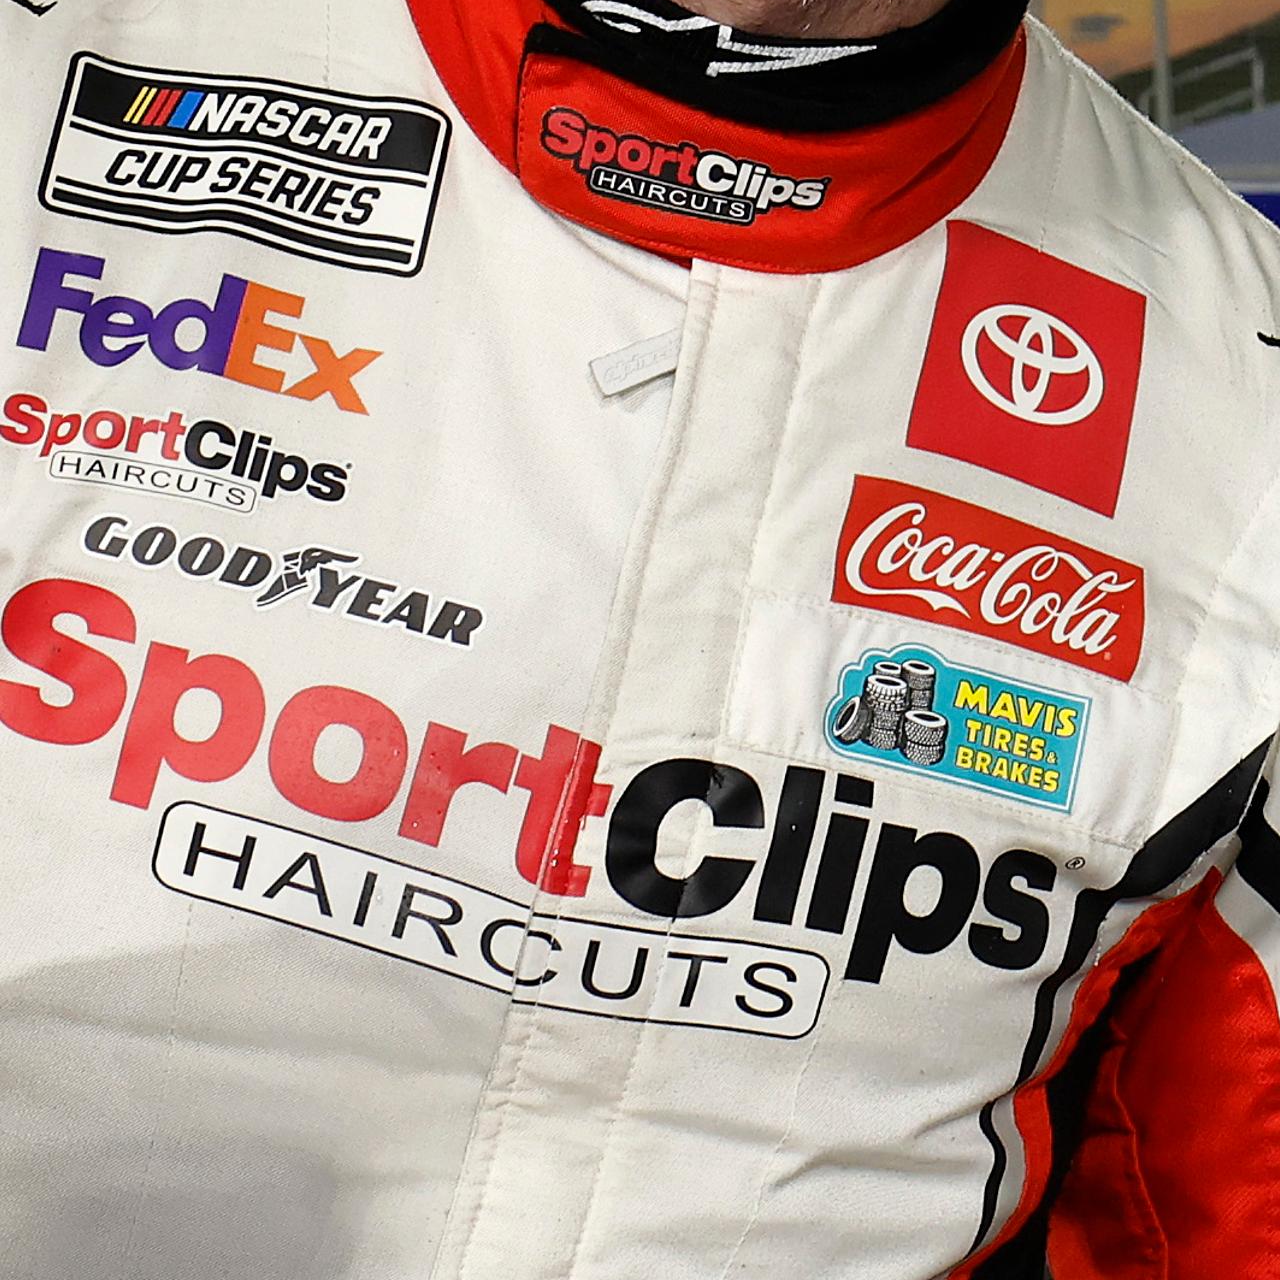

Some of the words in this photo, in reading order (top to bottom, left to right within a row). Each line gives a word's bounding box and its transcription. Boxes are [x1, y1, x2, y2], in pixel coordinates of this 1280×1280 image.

[193, 92, 392, 161] NASCAR
[105, 150, 211, 192] CUP
[211, 156, 382, 225] SERIES
[597, 171, 749, 220] HAIRCUTS
[15, 247, 384, 417] FedEx
[57, 456, 252, 508] HAIRCUTS
[845, 503, 1137, 657] Coca-Cola
[954, 681, 1080, 739] MAVIS
[955, 747, 1061, 794] BRAKES
[184, 821, 802, 1021] HAIRCUTS
